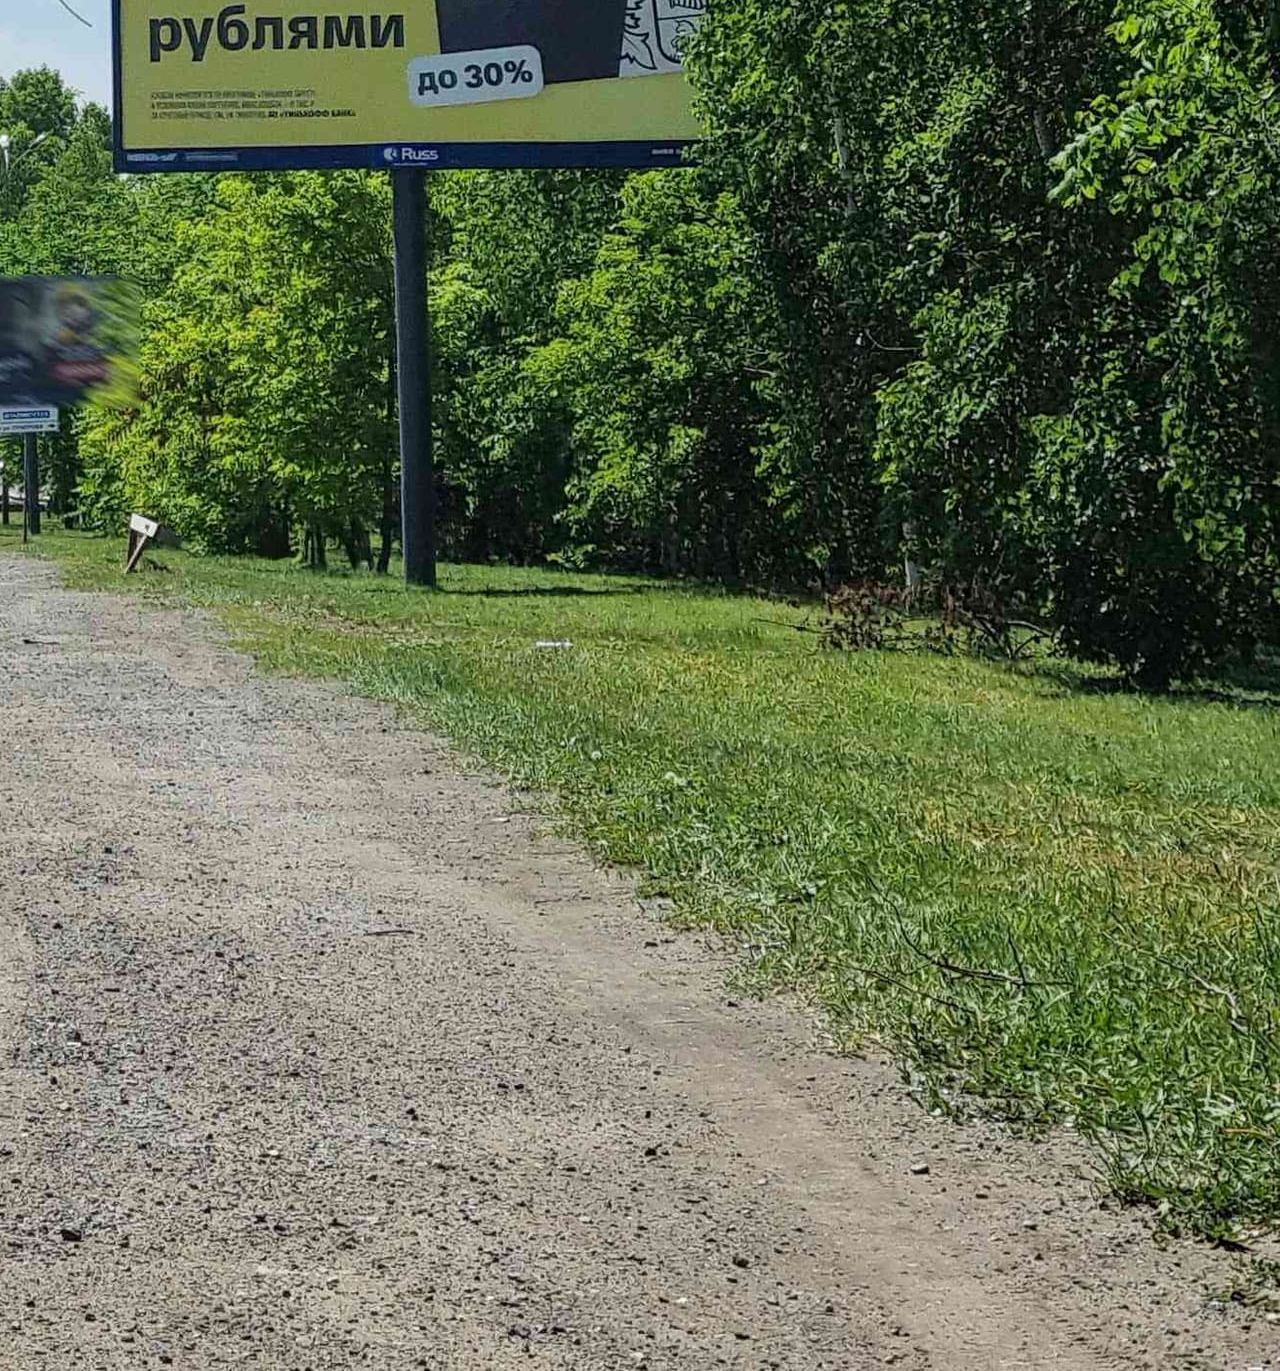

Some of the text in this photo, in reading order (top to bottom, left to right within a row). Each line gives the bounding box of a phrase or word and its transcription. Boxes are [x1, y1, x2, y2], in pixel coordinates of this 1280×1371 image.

[148, 4, 406, 62] рублями
[418, 59, 533, 96] до 30%
[401, 147, 439, 160] Russ
